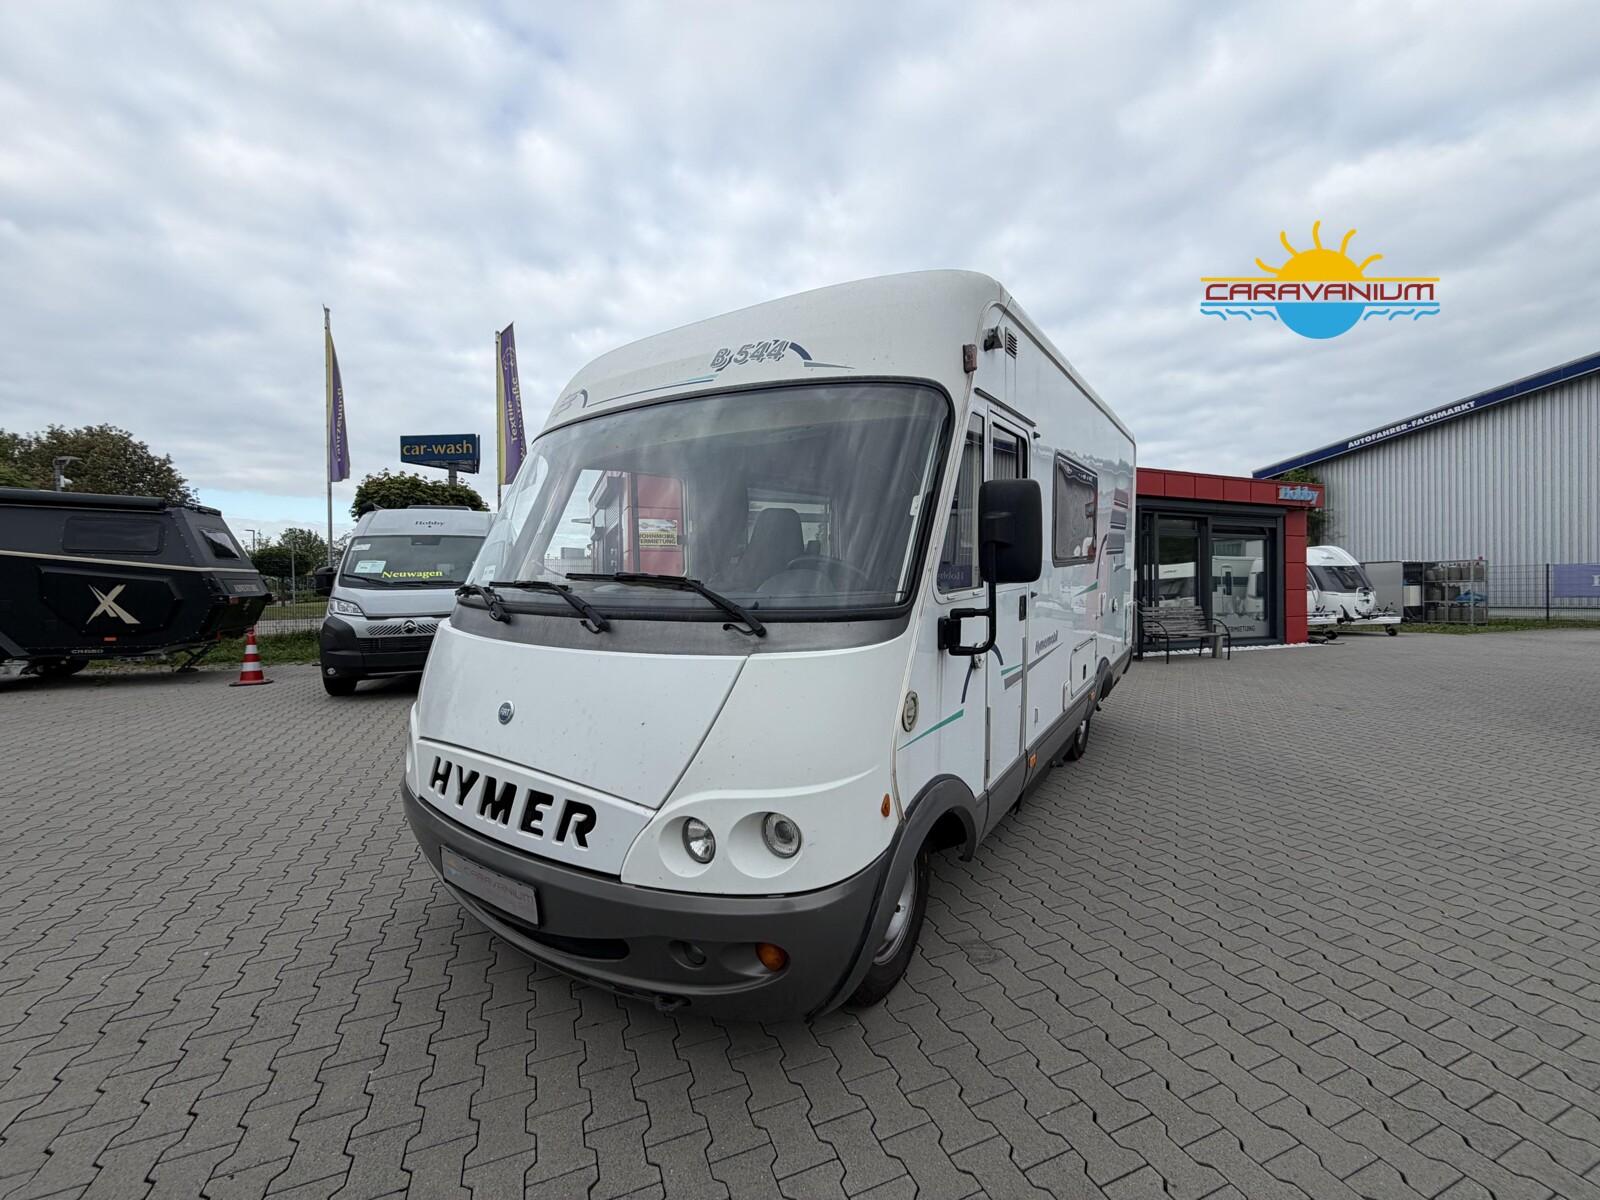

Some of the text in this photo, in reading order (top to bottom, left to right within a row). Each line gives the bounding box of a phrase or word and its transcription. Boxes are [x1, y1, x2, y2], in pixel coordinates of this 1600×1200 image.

[710, 339, 789, 372] B 544
[507, 400, 518, 442] Textile
[1347, 400, 1475, 449] AUTOFAHRER-FACHMARKT
[402, 440, 473, 456] car-wash
[1278, 485, 1320, 506] Hobby
[382, 570, 443, 579] Neuwagen
[430, 755, 598, 849] HYMER
